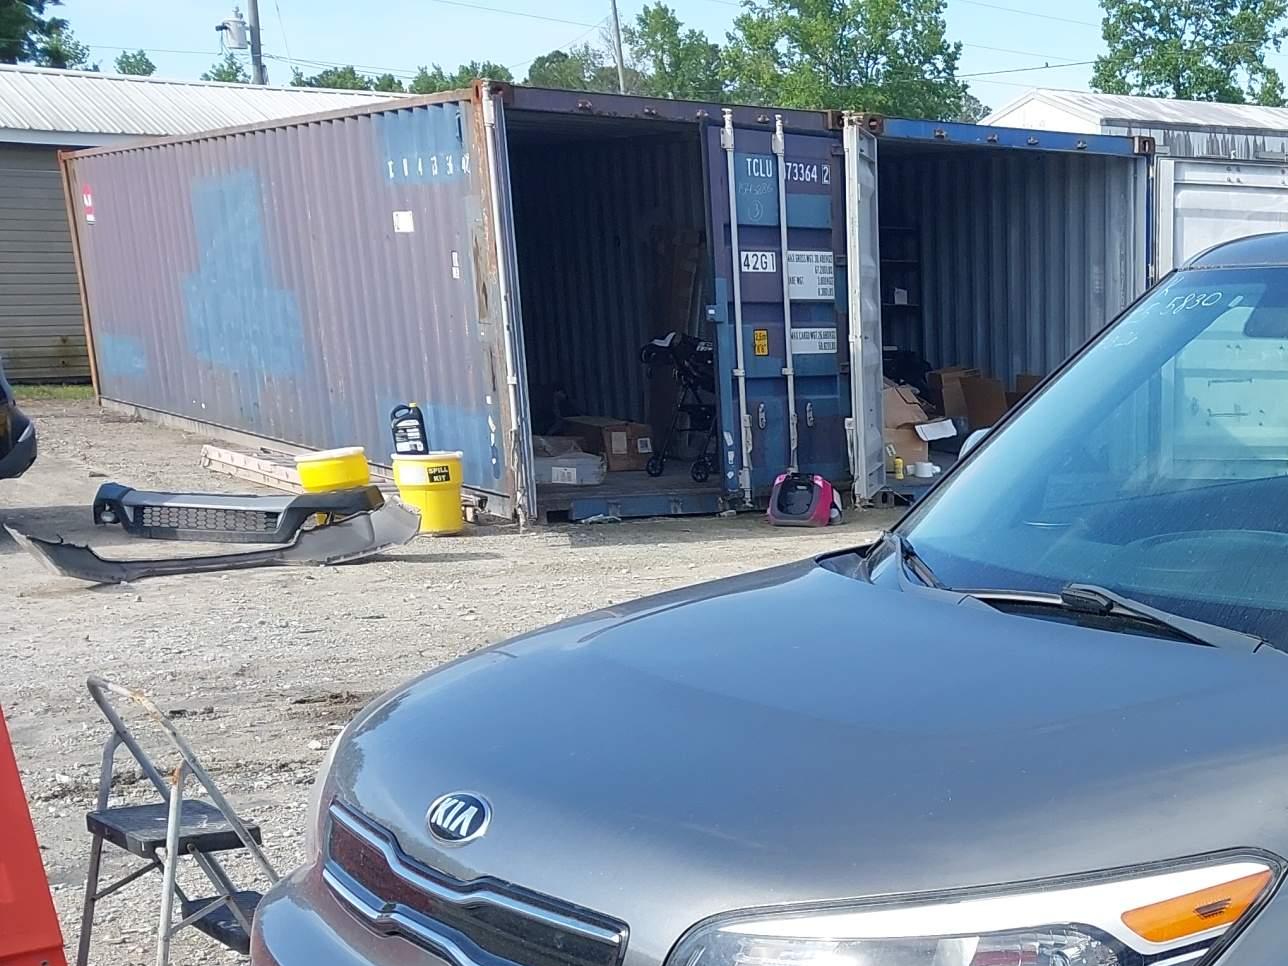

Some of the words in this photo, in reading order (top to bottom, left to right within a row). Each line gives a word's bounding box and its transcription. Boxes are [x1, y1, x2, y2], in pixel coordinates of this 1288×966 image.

[745, 158, 773, 178] TCLU
[743, 253, 775, 271] 42G1
[428, 466, 449, 475] SPILL
[432, 474, 447, 482] KIT
[430, 797, 479, 837] KIA
